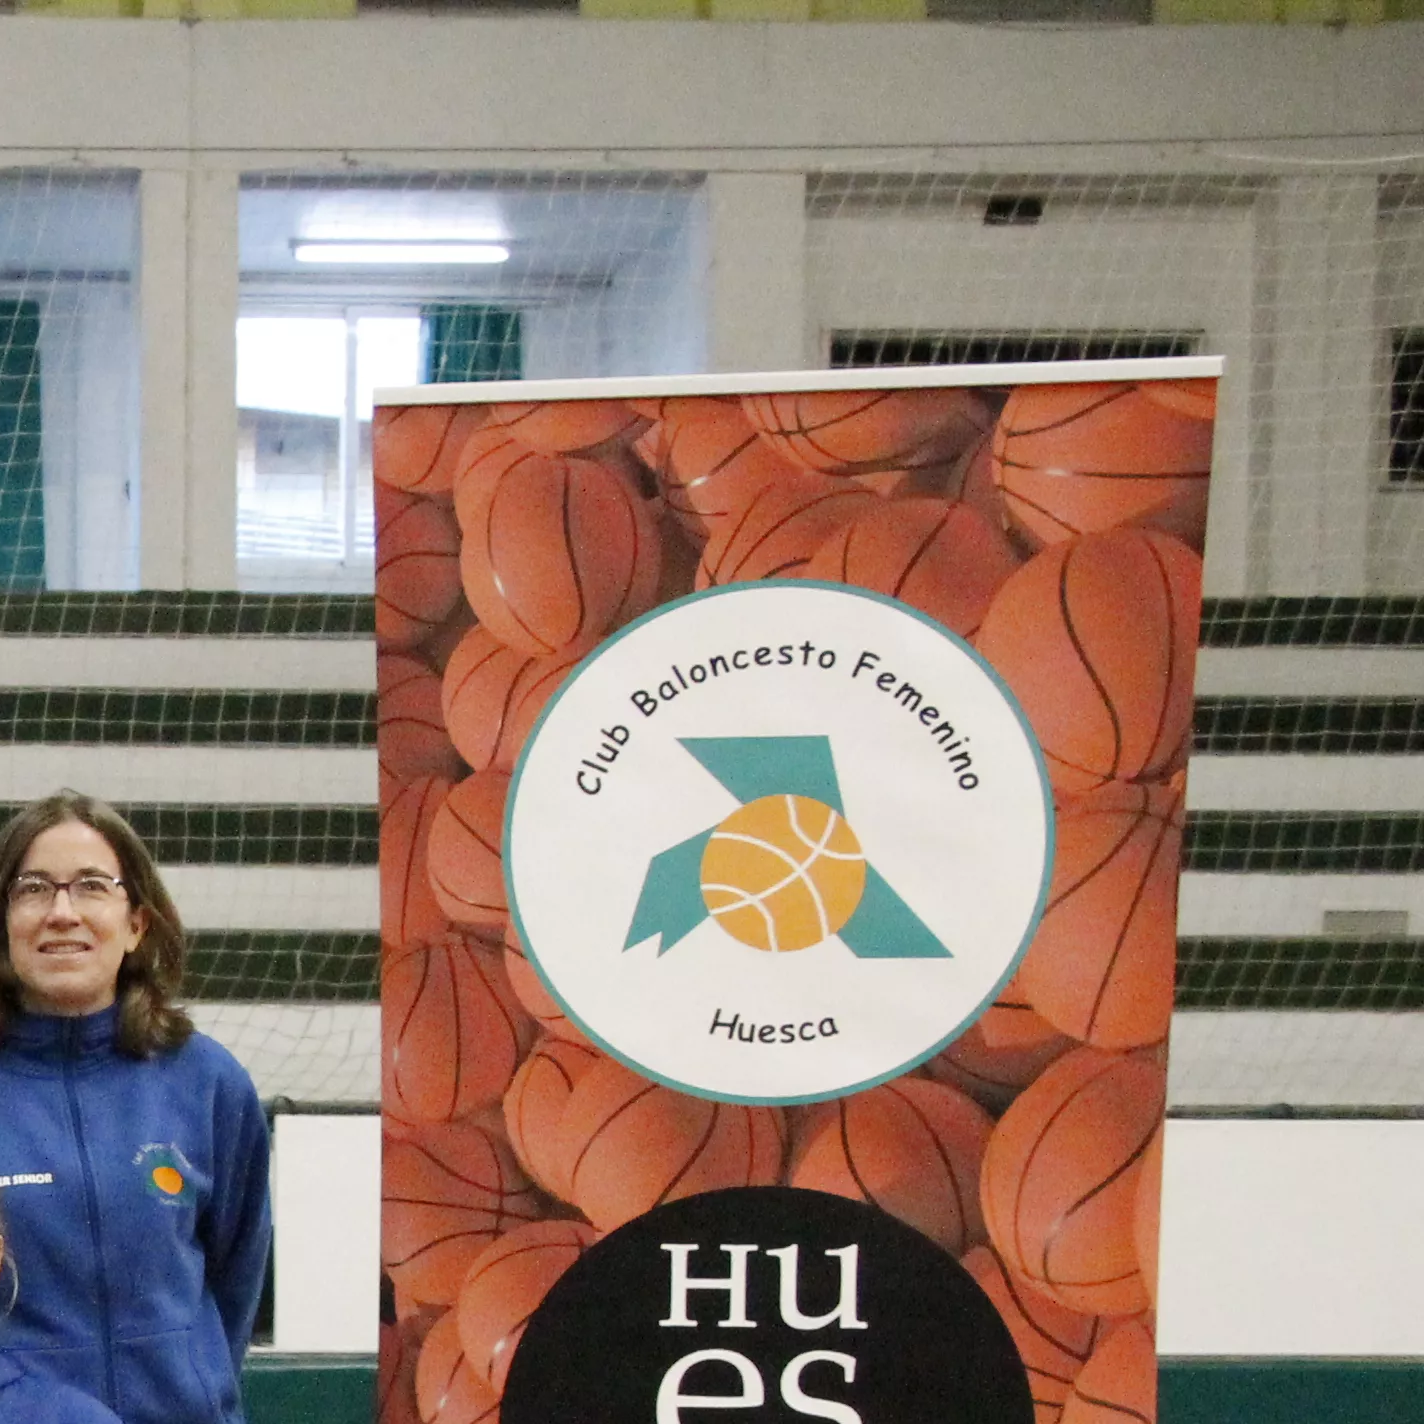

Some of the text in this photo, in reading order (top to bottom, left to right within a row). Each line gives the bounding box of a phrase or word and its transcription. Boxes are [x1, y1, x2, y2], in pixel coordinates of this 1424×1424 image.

[576, 640, 980, 796] Club Baloncesto Femenino
[709, 1008, 839, 1044] Huesca
[12, 1172, 53, 1185] SENIOR
[658, 1243, 869, 1331] Hu
